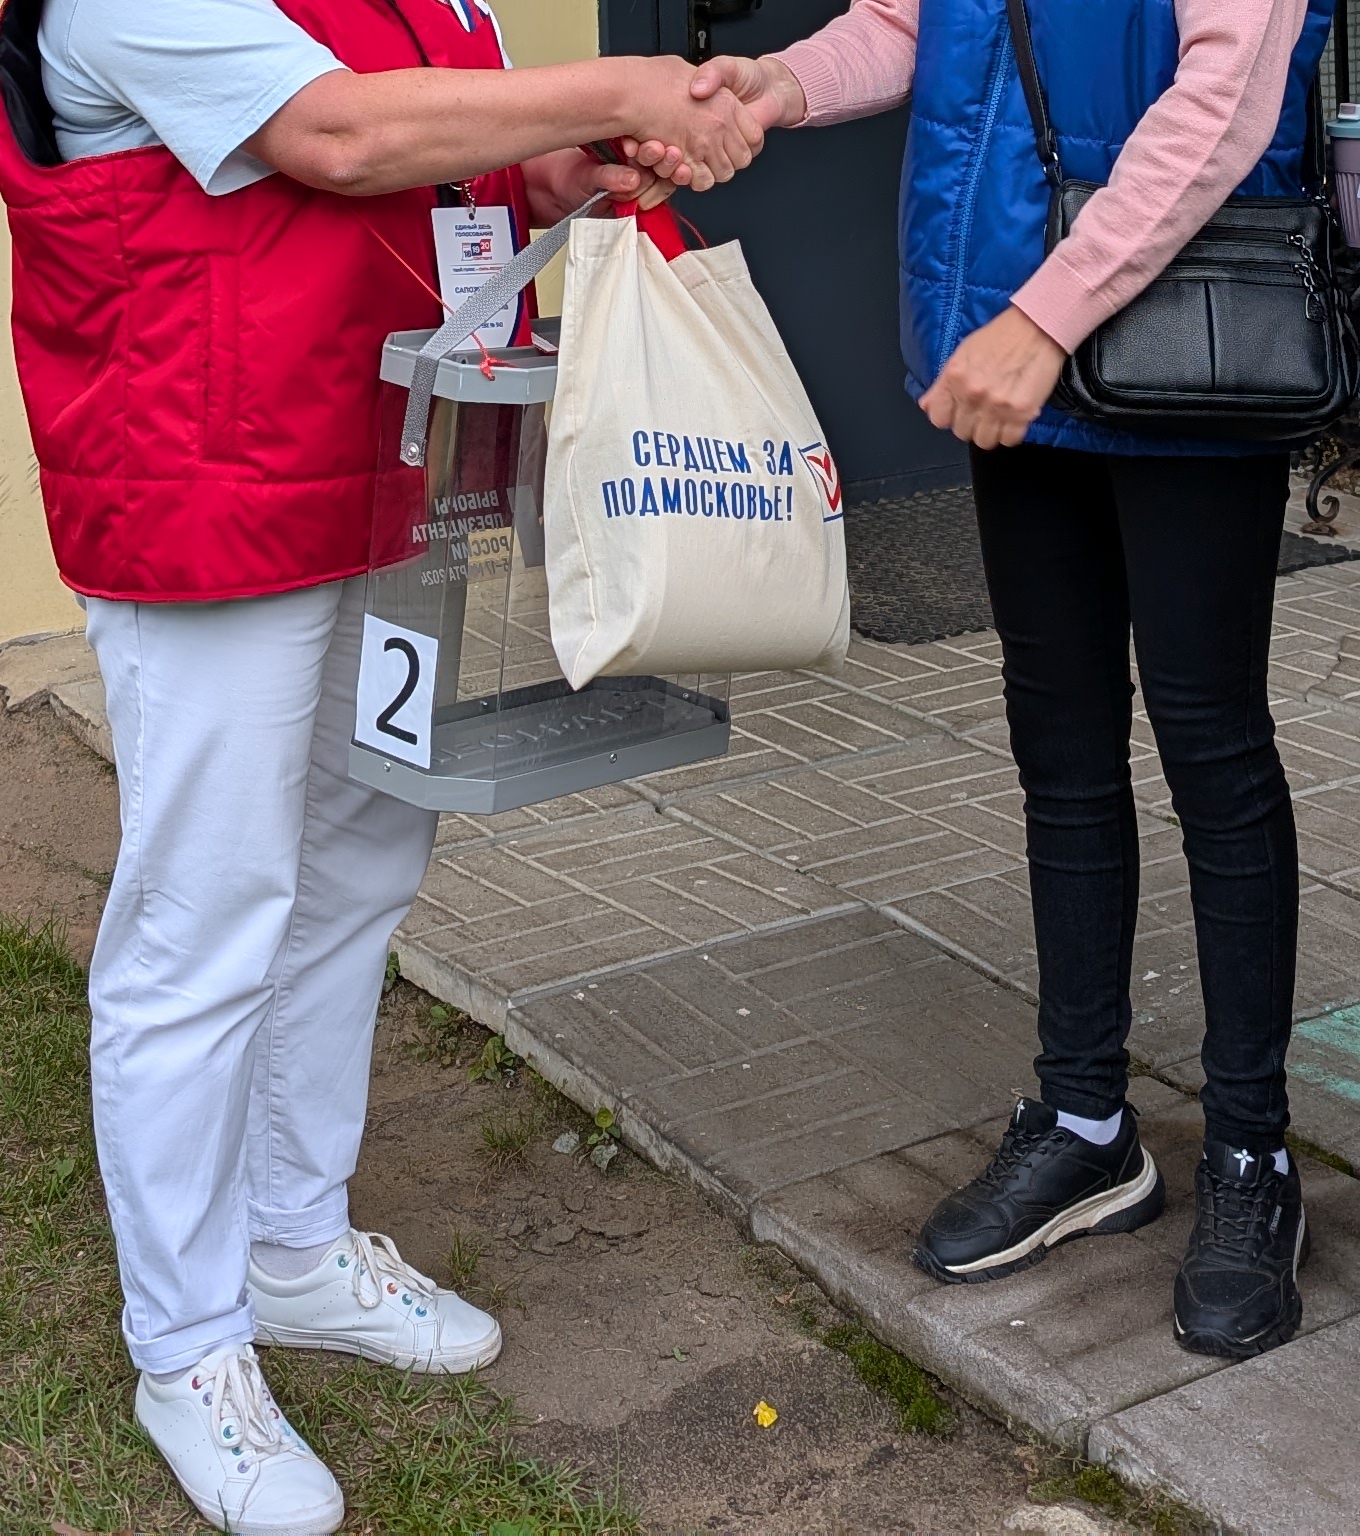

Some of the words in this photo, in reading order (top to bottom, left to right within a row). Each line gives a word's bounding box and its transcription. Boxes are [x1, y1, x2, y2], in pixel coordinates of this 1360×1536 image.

[632, 430, 752, 474] СЕРДЦЕМ
[763, 440, 794, 476] ЗА
[602, 477, 793, 521] ПОДМОСКОВЬЕ!
[375, 637, 420, 746] 2
